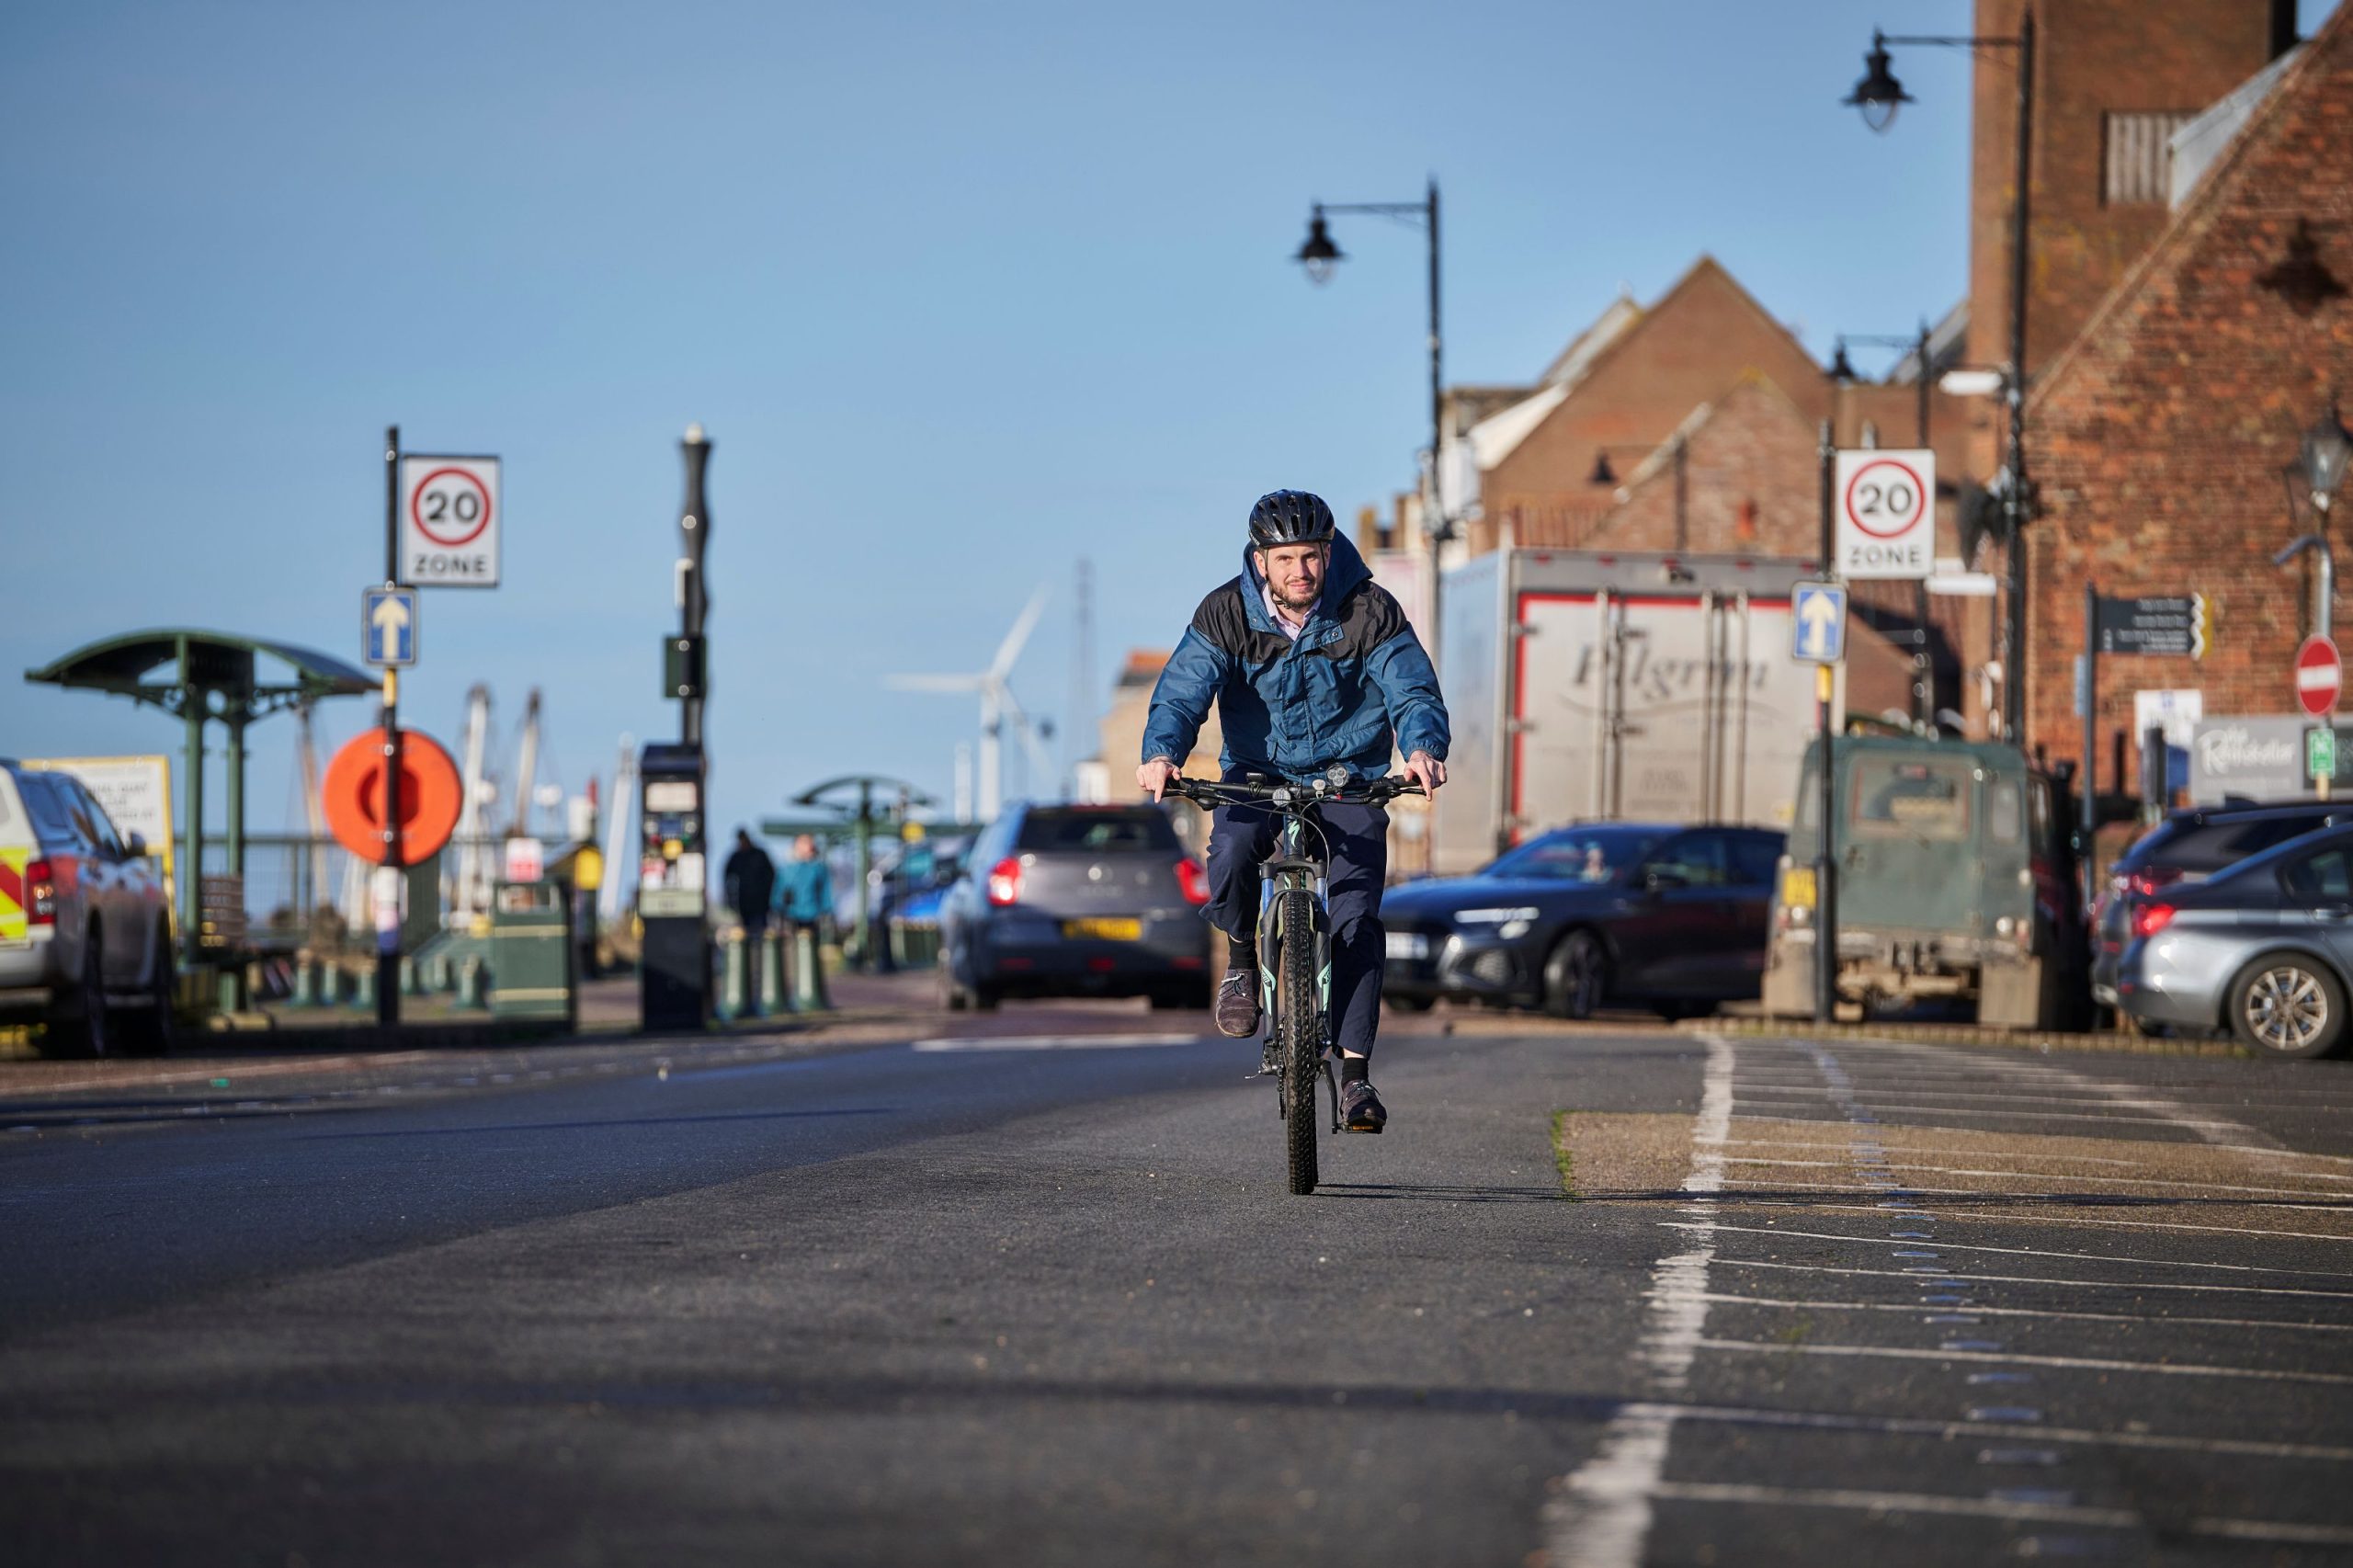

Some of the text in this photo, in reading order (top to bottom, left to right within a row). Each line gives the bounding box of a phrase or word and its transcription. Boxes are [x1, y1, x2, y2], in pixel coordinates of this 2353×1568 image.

[426, 490, 479, 523] 20
[1859, 484, 1912, 517] 20
[415, 554, 487, 574] ZONE
[1849, 545, 1920, 567] ZONE
